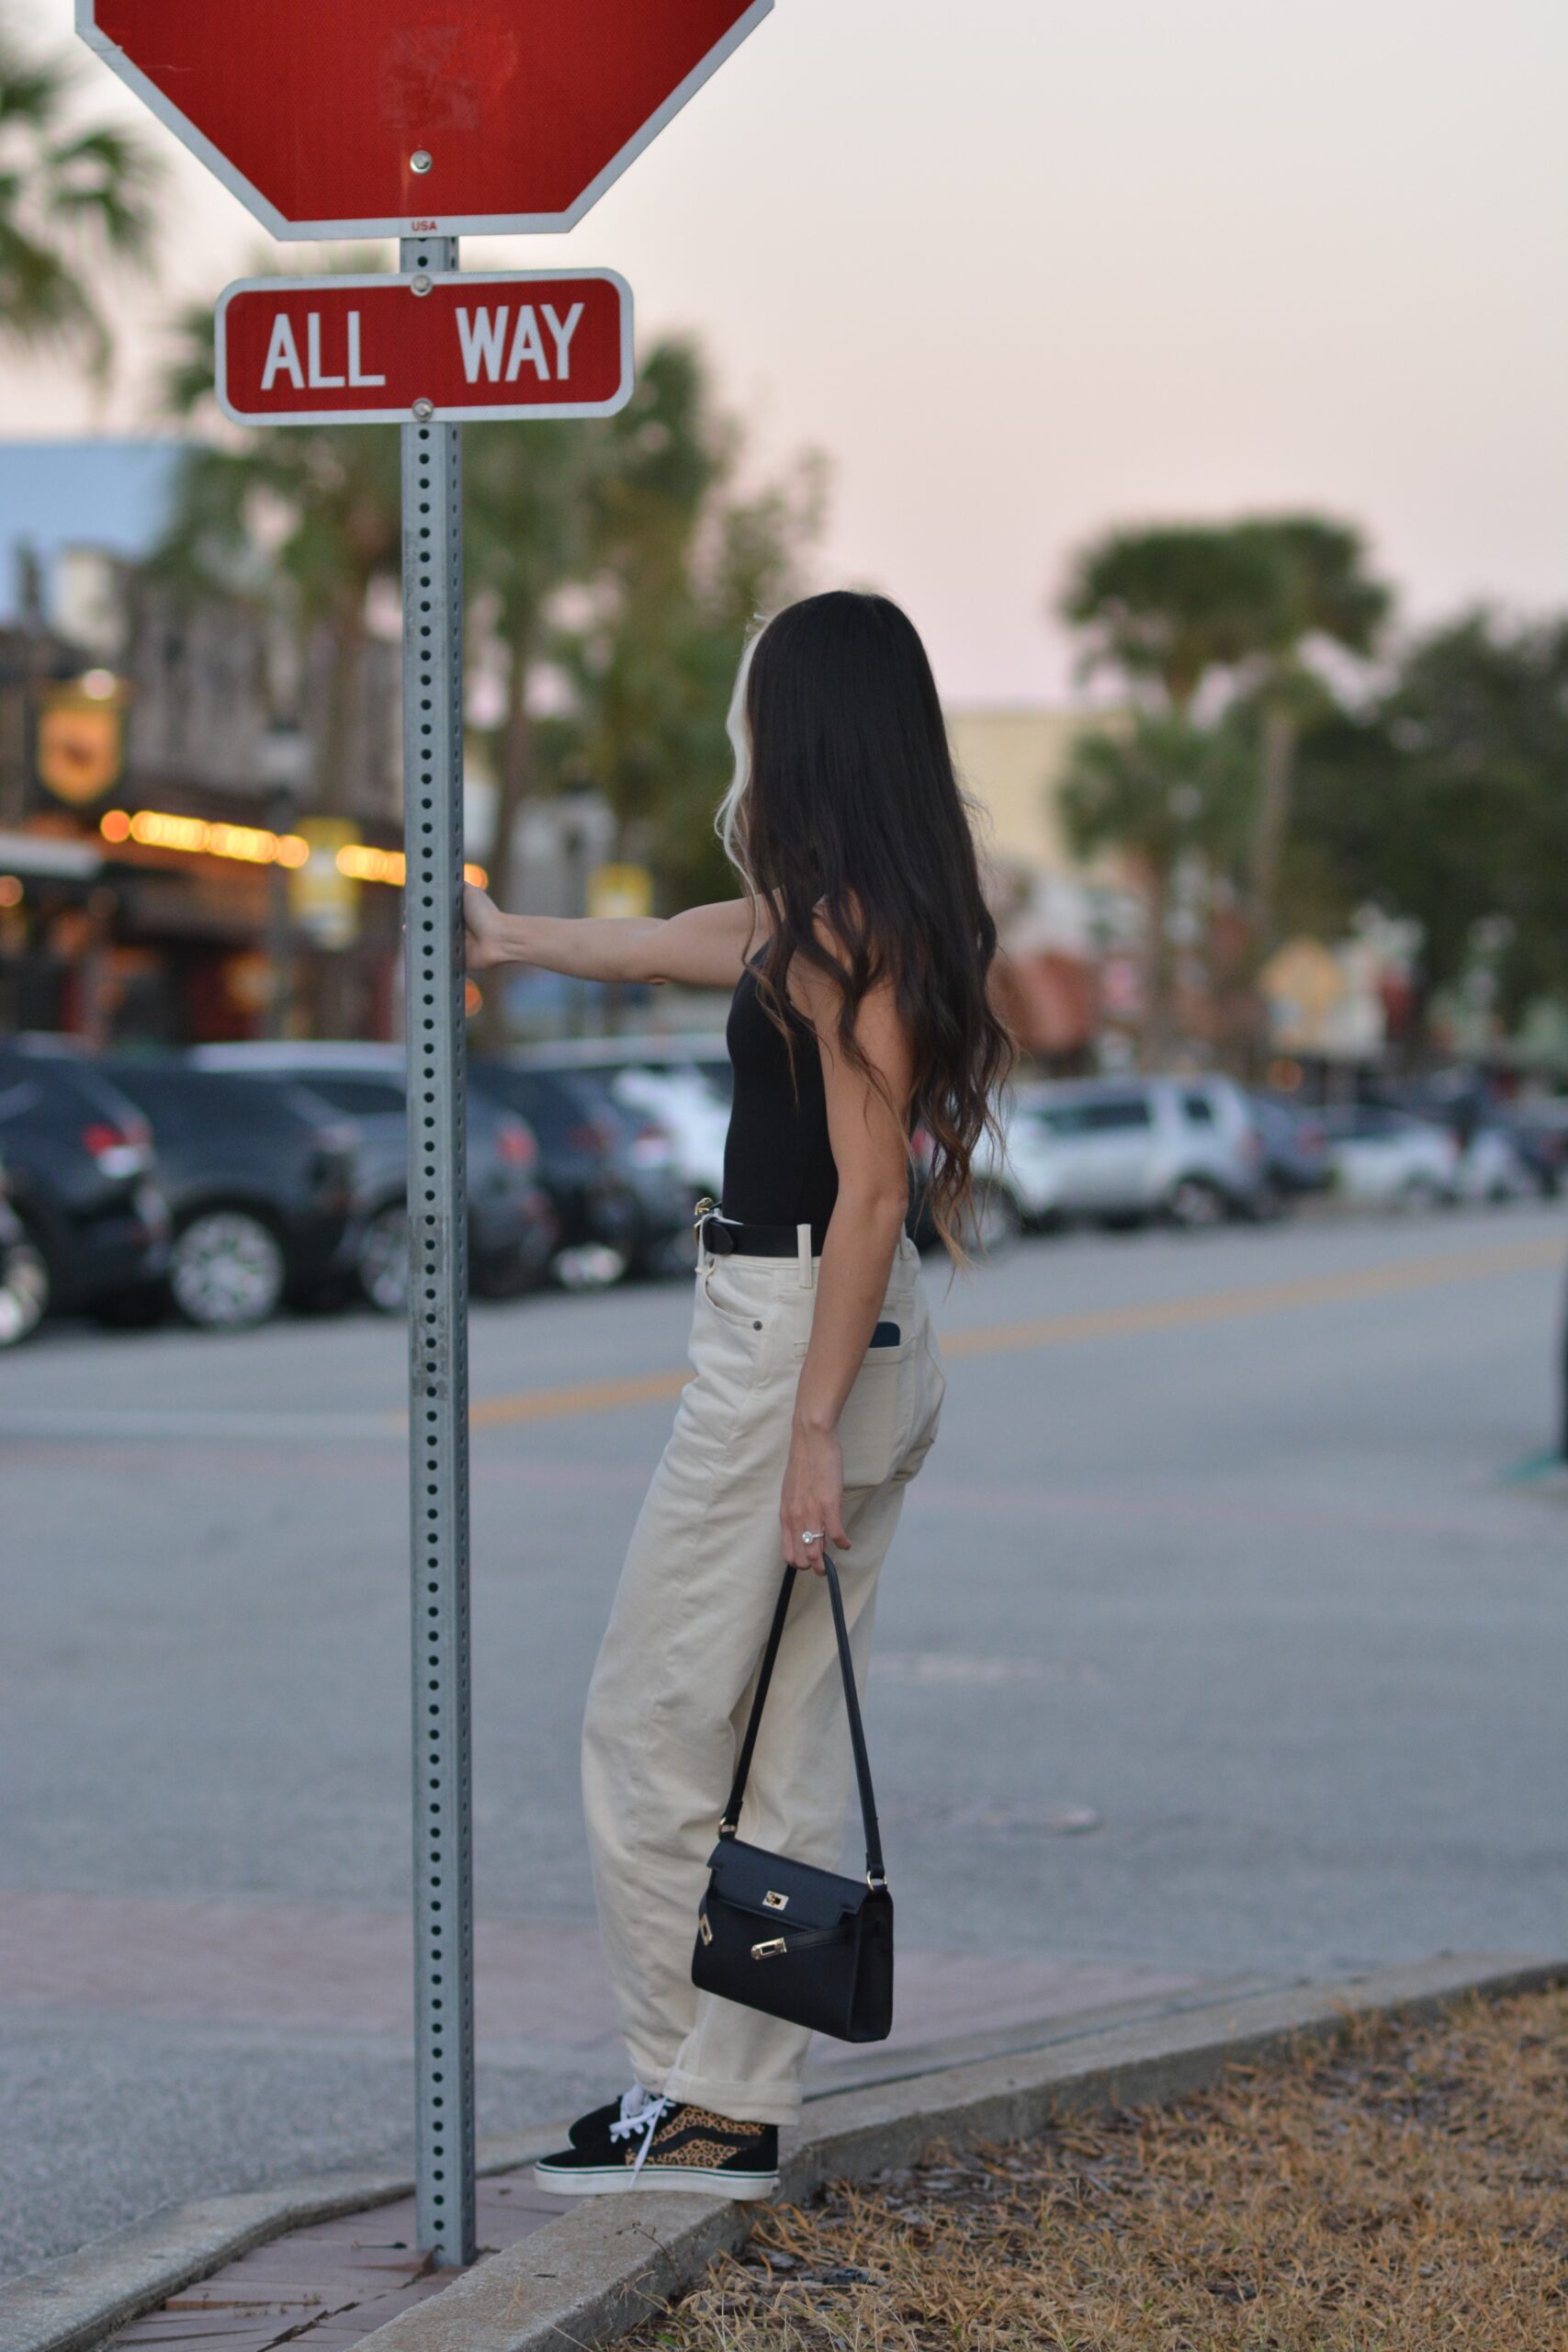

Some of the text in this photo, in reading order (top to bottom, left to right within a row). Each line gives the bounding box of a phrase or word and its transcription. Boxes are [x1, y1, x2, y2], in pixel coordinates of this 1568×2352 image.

[412, 220, 438, 232] USA
[261, 303, 584, 390] ALL WAY
